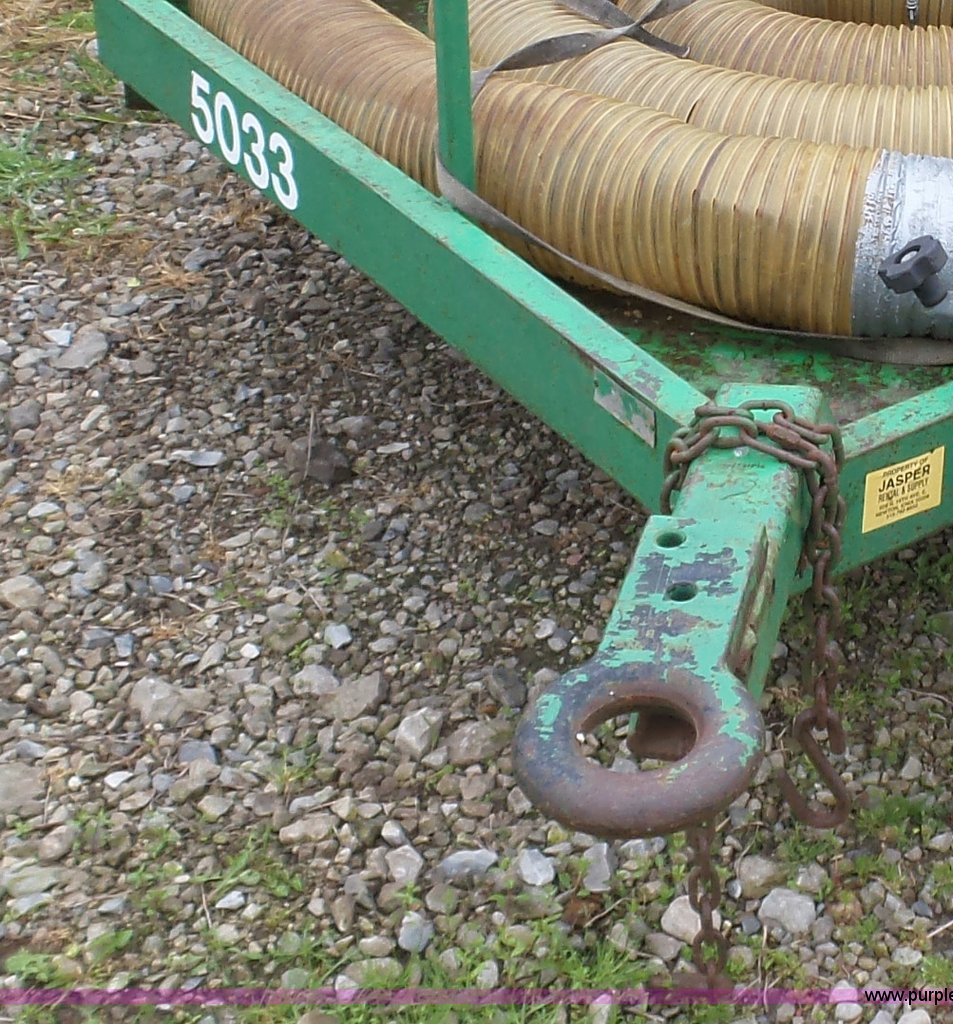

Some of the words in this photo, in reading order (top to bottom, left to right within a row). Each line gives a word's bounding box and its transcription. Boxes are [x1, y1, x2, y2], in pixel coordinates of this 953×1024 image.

[190, 69, 299, 210] 5033
[878, 464, 931, 493] JASPER
[882, 460, 919, 478] PROPERTY
[919, 457, 929, 467] OF
